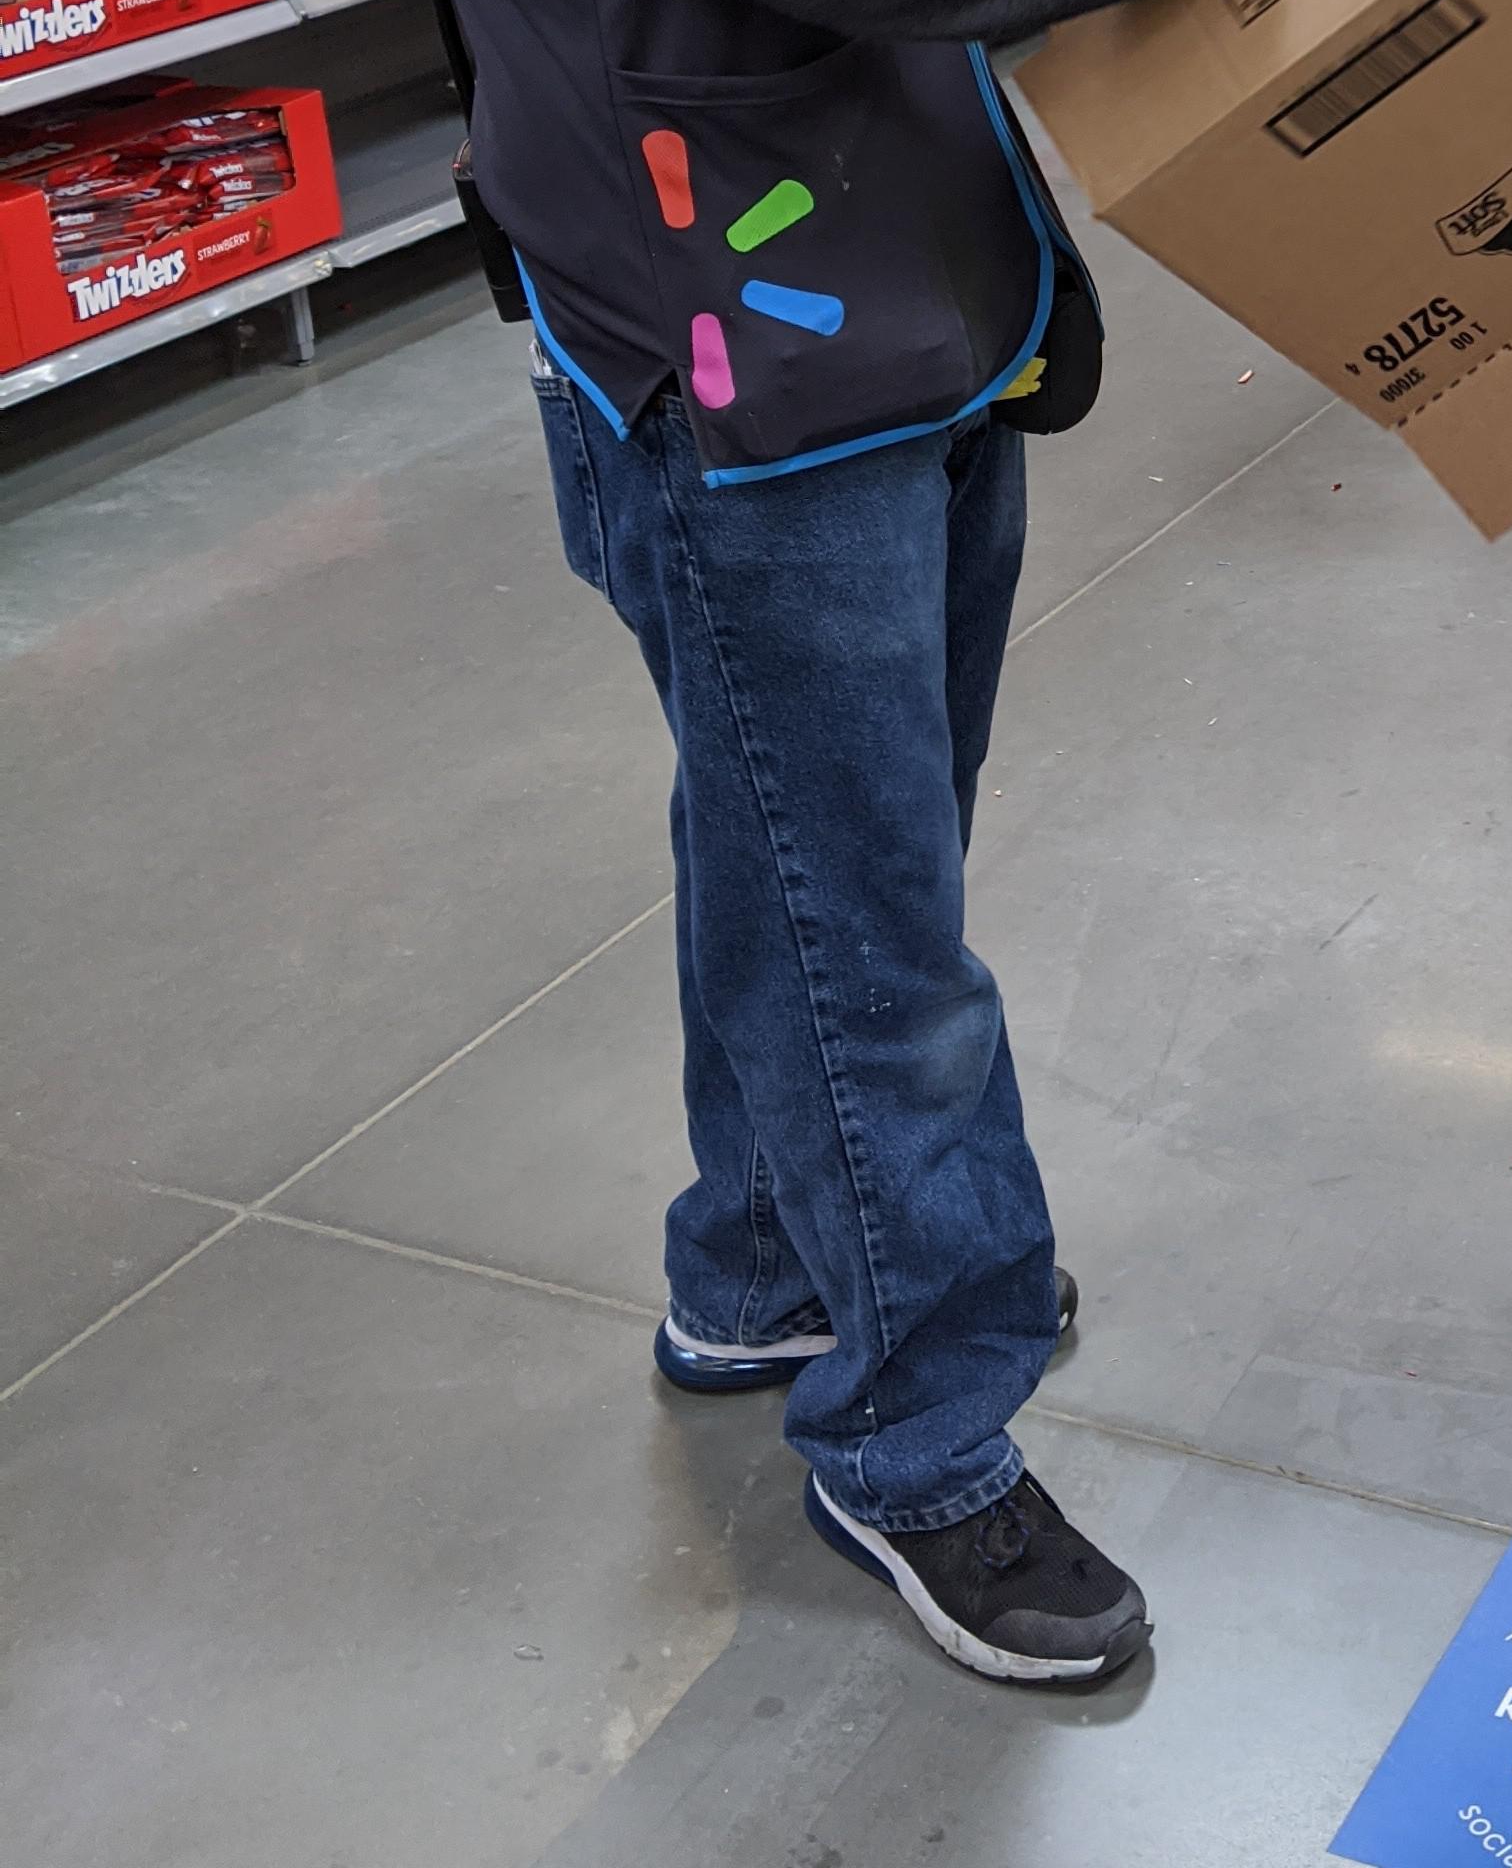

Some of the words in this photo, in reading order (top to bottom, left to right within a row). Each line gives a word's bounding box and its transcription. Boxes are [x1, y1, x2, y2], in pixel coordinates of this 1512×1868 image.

[1447, 191, 1508, 236] Soft
[198, 231, 250, 261] STRAWBERRY
[68, 249, 186, 321] Twizzlers
[1363, 296, 1466, 373] 52778
